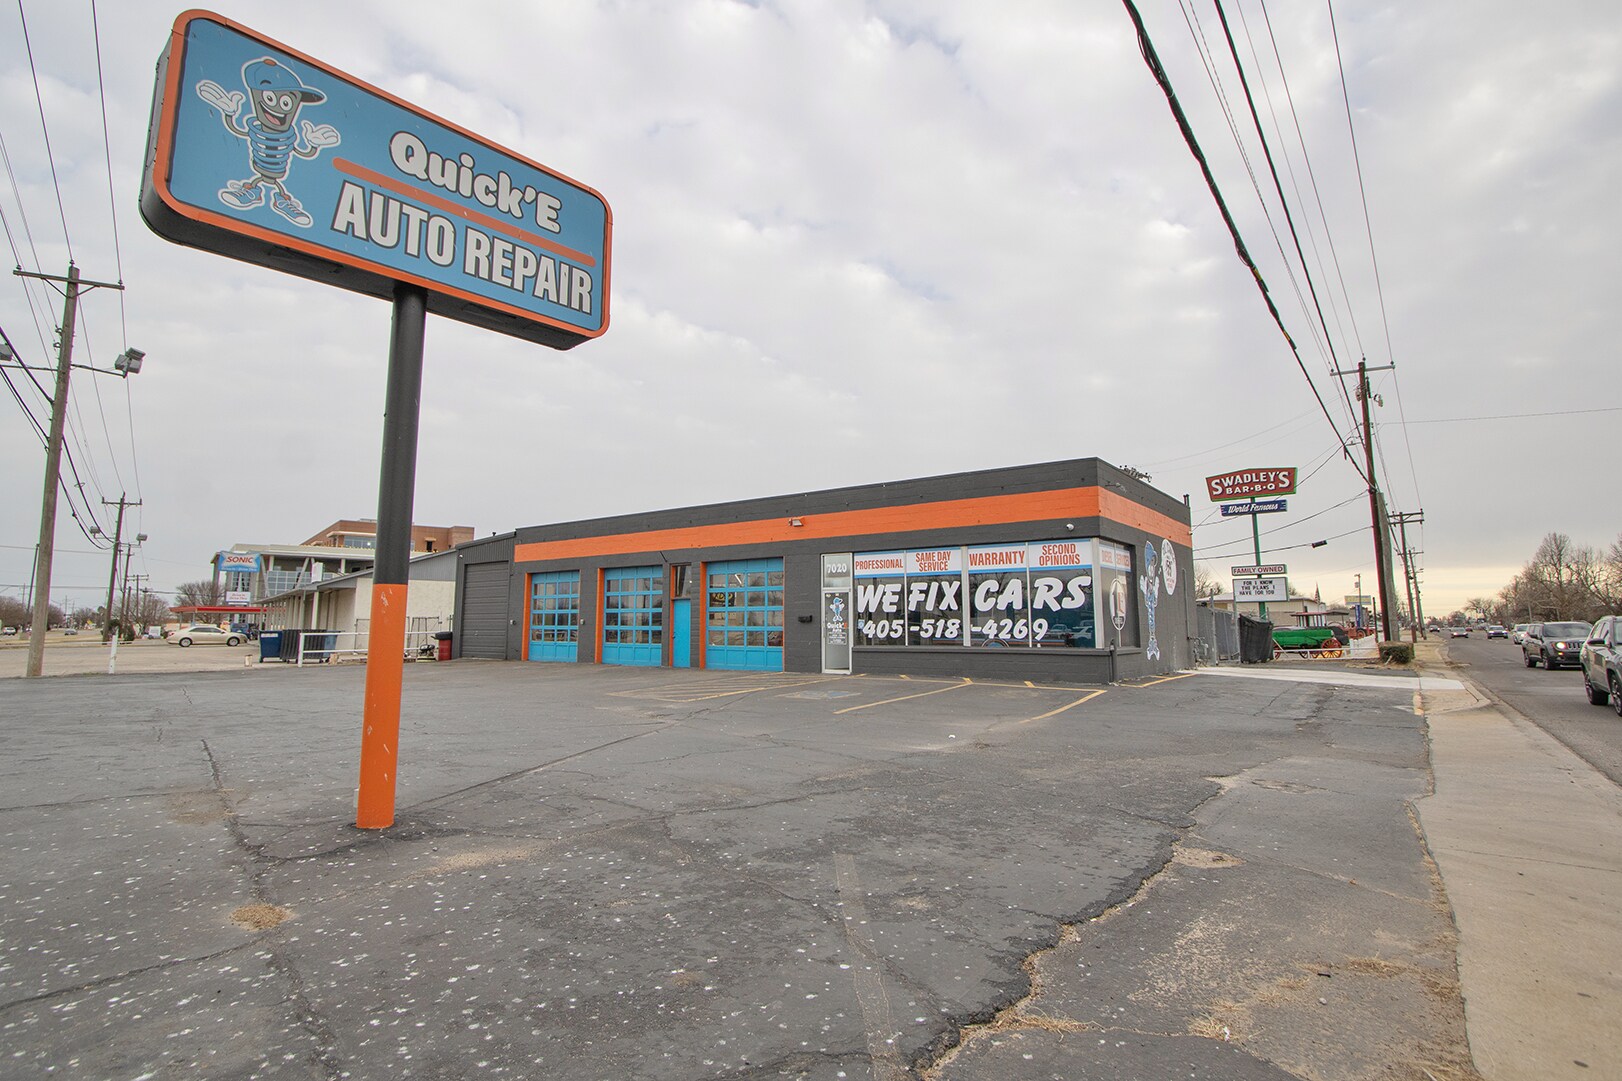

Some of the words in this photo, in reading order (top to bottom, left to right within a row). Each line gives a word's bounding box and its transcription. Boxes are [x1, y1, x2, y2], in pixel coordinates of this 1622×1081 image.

[389, 130, 562, 234] Quick'E
[331, 179, 457, 268] AUTO
[462, 225, 593, 316] REPAIR
[1211, 471, 1291, 495] SWADLEY'S
[1228, 505, 1249, 513] World
[1250, 503, 1279, 511] Famous
[1042, 543, 1076, 555] SECOND
[915, 552, 936, 562] SAME
[937, 551, 951, 561] DAY
[969, 550, 1025, 566] WARRANTY
[1039, 554, 1080, 566] OPINIONS
[826, 563, 847, 573] 7020
[855, 558, 904, 570] PROFESSIONAL
[918, 560, 949, 572] SERVICE
[857, 583, 902, 613] WE
[908, 580, 961, 612] FIX
[974, 575, 1092, 612] CARS
